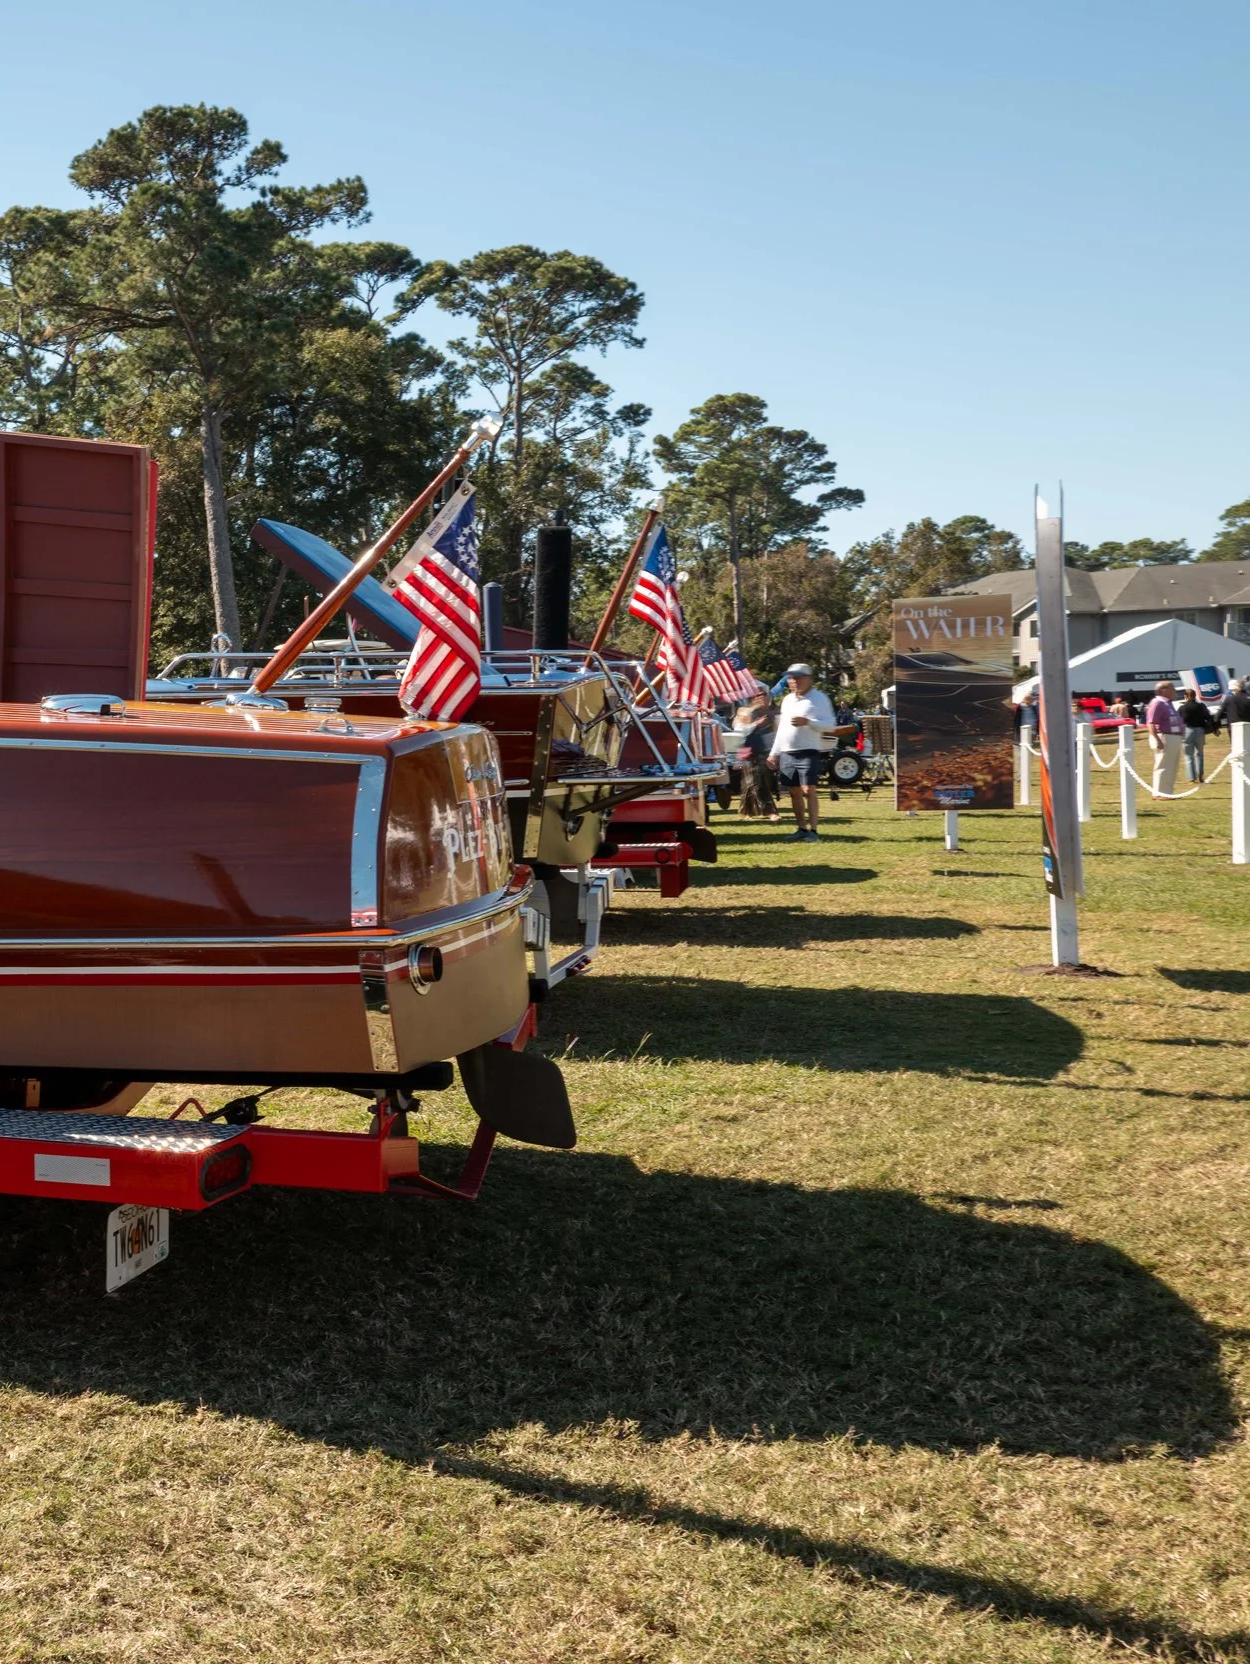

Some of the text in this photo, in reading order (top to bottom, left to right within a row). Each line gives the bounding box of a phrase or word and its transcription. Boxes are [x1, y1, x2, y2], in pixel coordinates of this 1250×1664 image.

[900, 605, 953, 618] On the
[905, 615, 1005, 640] WATER
